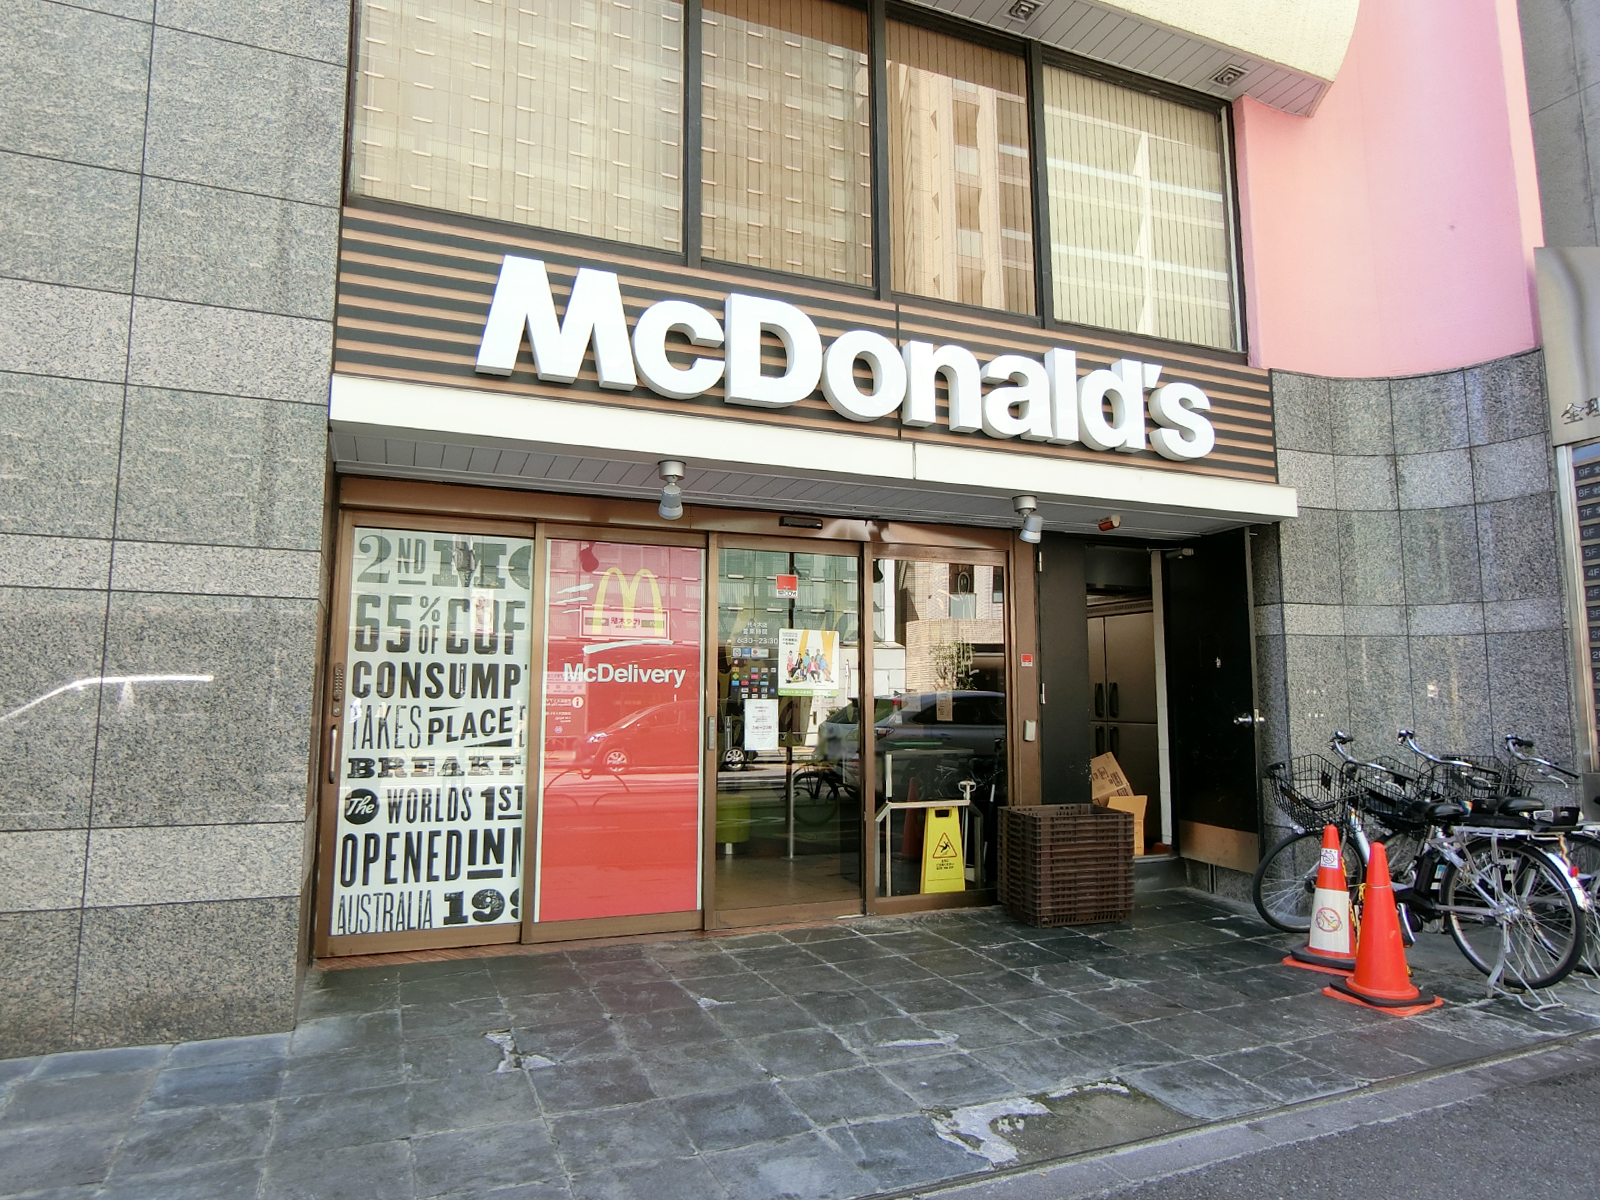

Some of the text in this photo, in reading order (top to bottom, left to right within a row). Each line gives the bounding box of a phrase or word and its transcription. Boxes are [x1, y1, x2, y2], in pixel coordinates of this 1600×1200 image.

[475, 254, 1215, 461] McDonald's
[1578, 467, 1591, 478] 9F
[1578, 487, 1591, 498] 8F
[1580, 507, 1593, 517] 7F
[1583, 528, 1595, 538] 6F
[1585, 548, 1598, 558] 5F
[1587, 567, 1600, 577] 4F
[1587, 588, 1600, 598] 4F
[1589, 609, 1600, 619] 3F
[418, 623, 440, 655] OF
[352, 660, 528, 699] CONSUMP
[563, 662, 686, 689] McDelivery
[349, 704, 422, 749] TAKES
[427, 705, 514, 746] PLACE
[347, 755, 522, 779] BREAKF
[346, 795, 376, 816] The
[387, 786, 472, 824] WORLDS
[340, 829, 462, 888] OPENED
[467, 827, 506, 867] IN
[337, 887, 520, 936] AUSTRALIA 19
